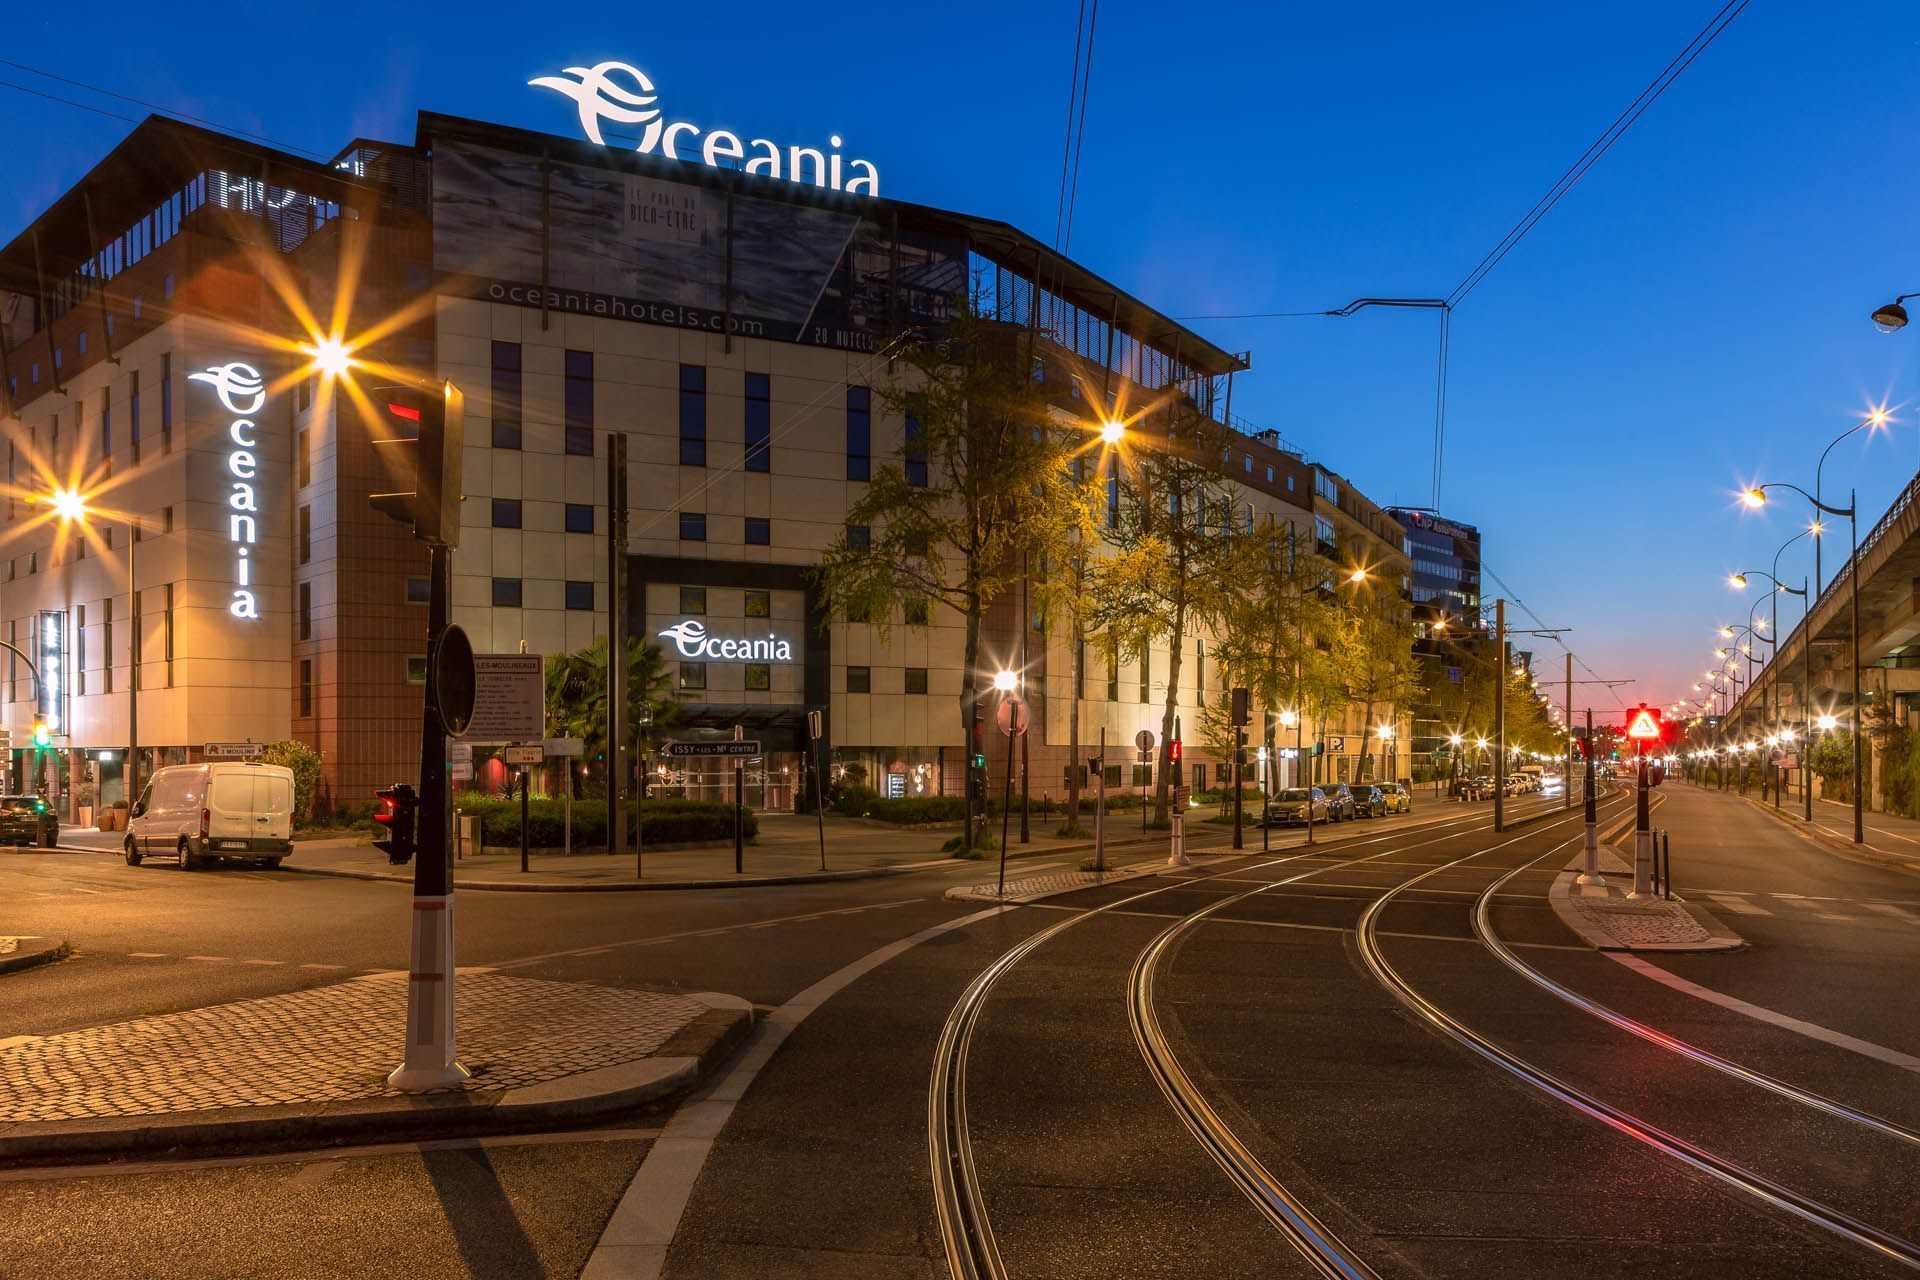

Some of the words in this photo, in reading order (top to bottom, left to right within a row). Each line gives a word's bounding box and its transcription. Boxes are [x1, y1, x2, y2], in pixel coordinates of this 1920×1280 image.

[528, 61, 879, 198] Oceania
[487, 282, 765, 336] oceaniahotels.com
[187, 362, 266, 620] Oceania
[658, 620, 792, 660] Oceania
[729, 744, 755, 754] CENTRE
